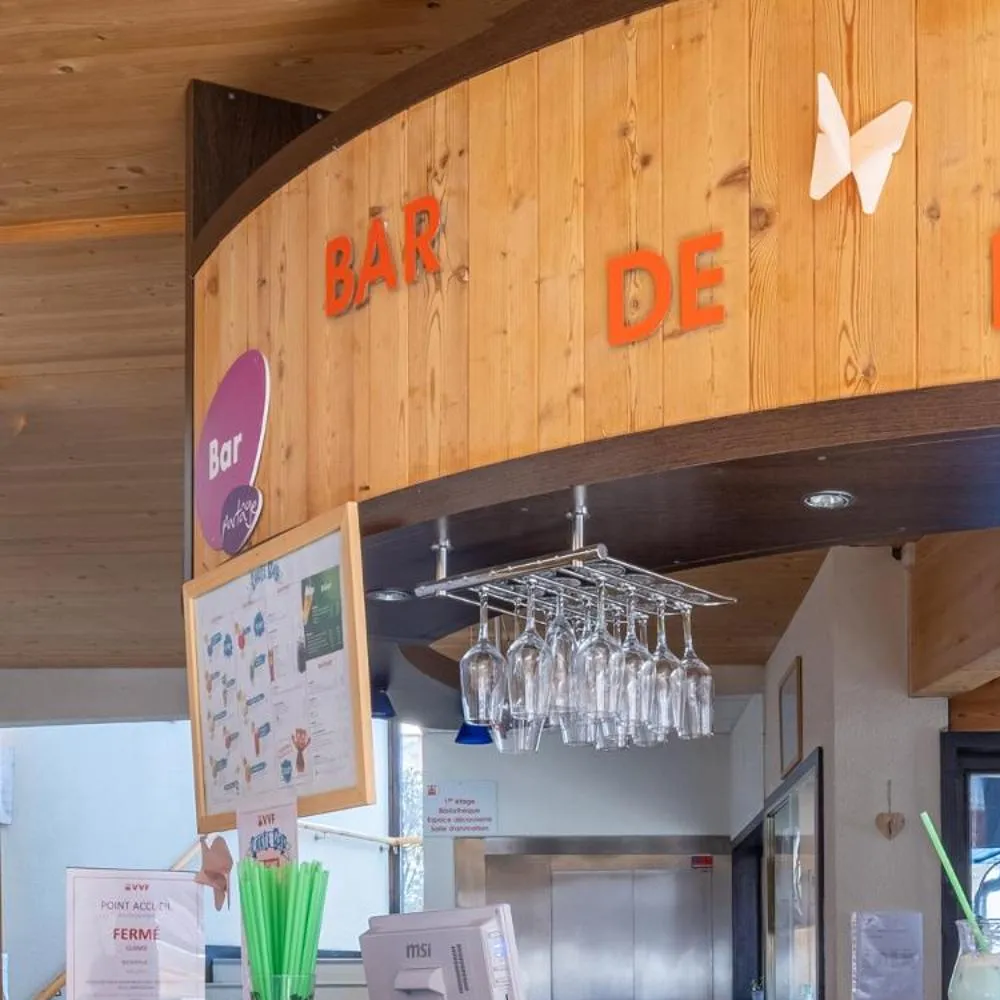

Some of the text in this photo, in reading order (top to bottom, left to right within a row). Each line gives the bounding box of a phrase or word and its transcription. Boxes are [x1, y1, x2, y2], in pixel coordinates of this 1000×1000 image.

[324, 193, 441, 318] BAR
[605, 231, 726, 348] DE
[208, 432, 243, 481] Bar
[101, 900, 130, 911] POINT
[113, 925, 161, 941] FERMÉ
[406, 943, 431, 959] msi
